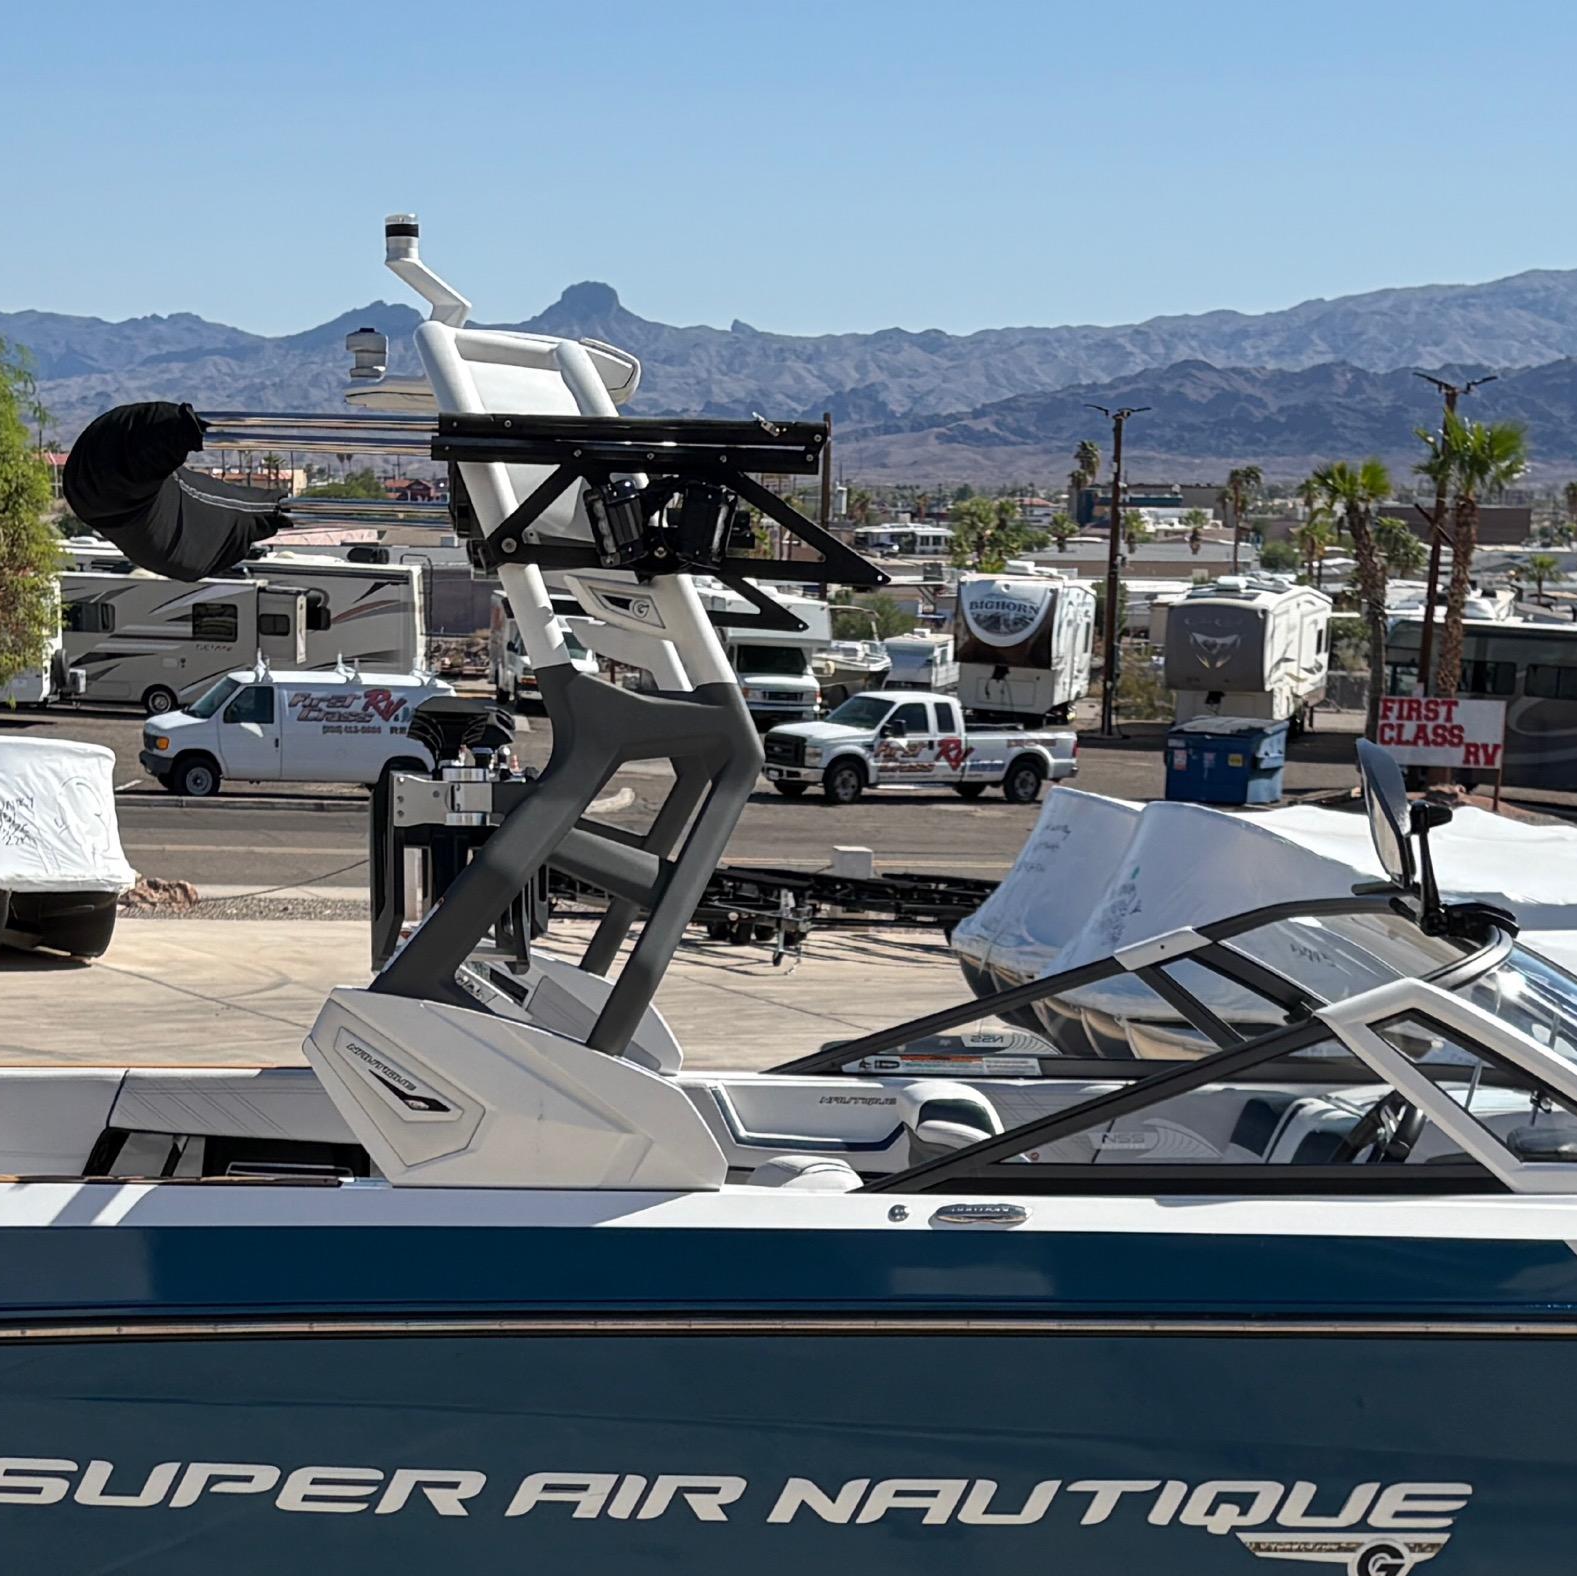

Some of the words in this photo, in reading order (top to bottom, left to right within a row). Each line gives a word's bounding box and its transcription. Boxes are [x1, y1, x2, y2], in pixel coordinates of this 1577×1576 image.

[969, 600, 1040, 615] BIGHORN
[1379, 697, 1460, 722] FIRST
[1379, 722, 1465, 746] CLASS
[1462, 742, 1502, 767] RV
[505, 1472, 747, 1521] AIR
[766, 1477, 1474, 1535] NAUTIQUE
